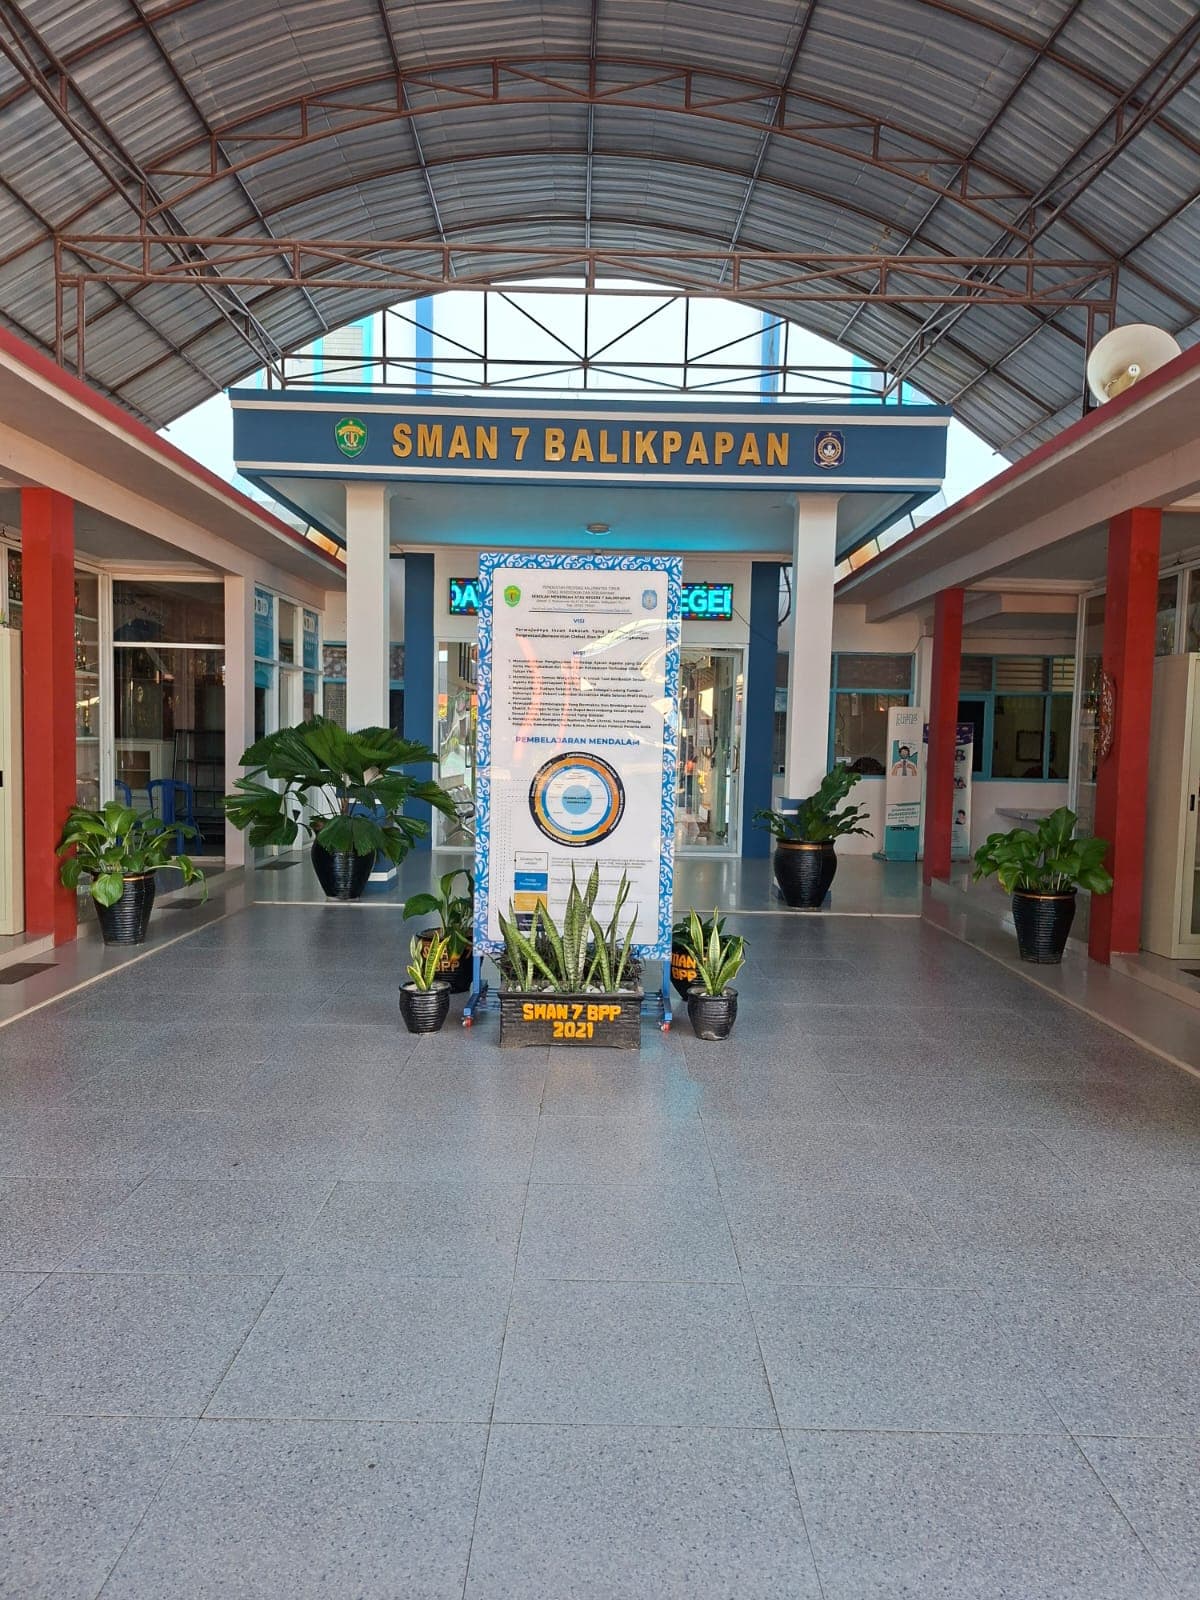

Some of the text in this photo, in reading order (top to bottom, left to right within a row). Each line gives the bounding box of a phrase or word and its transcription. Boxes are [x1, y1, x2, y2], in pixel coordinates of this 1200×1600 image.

[392, 423, 789, 466] SMAN 7 BALIKPAPAN
[515, 736, 640, 746] PEMBELAJARAN MENDALAM
[522, 1003, 622, 1021] SMAN 7 BPP
[552, 1021, 594, 1039] 2021
